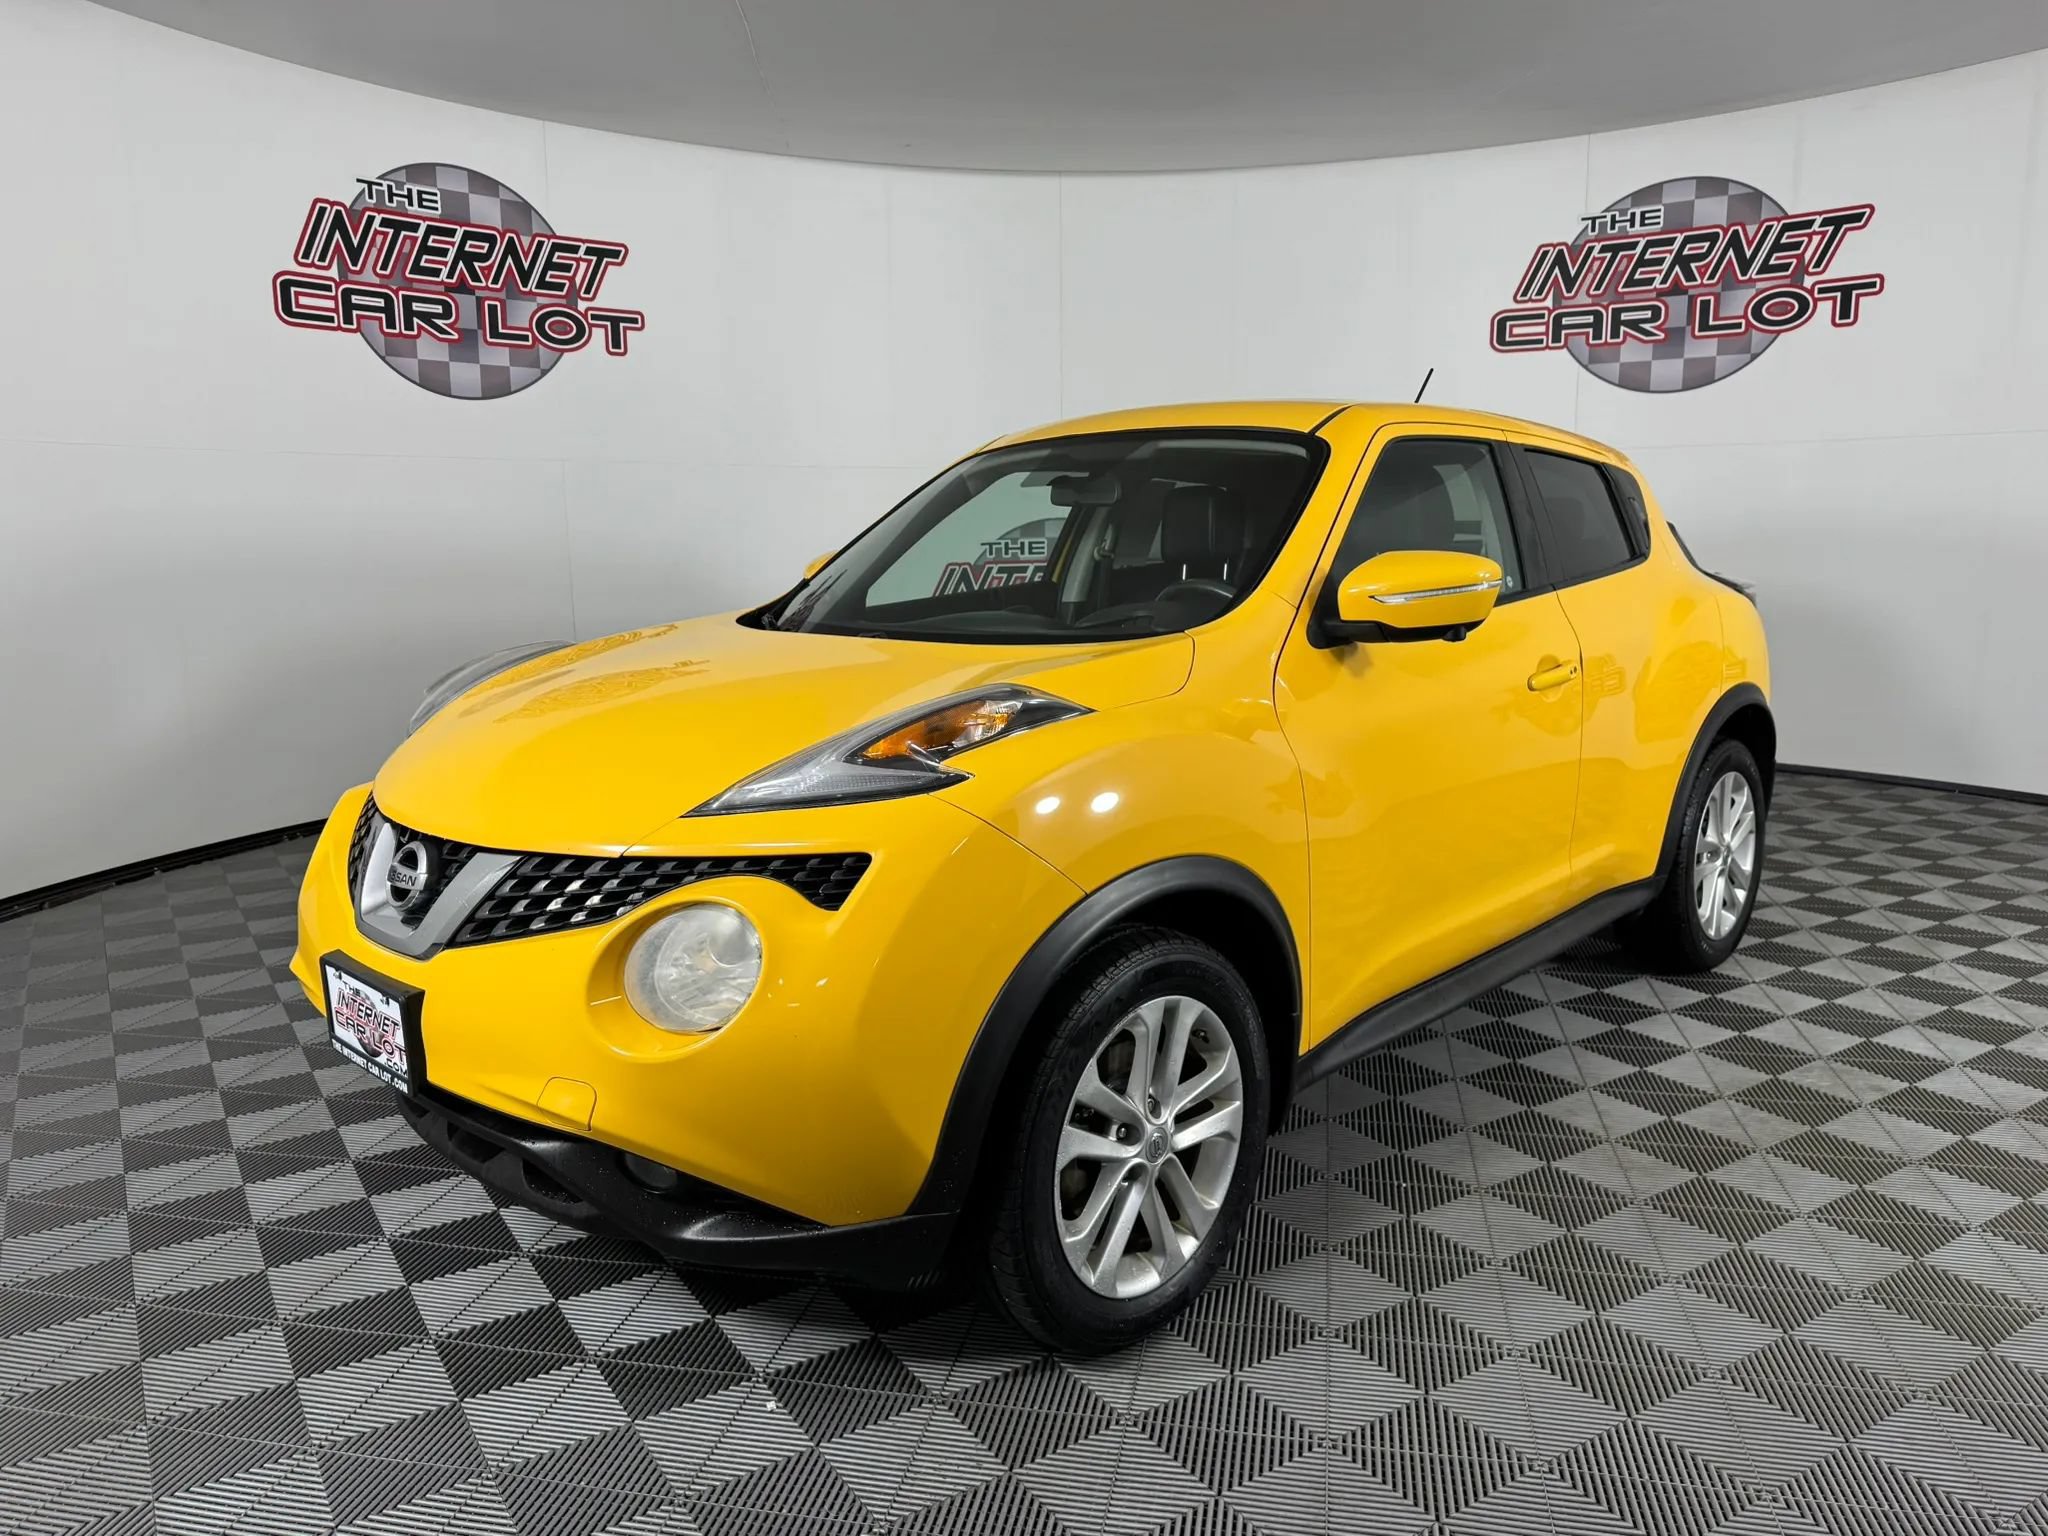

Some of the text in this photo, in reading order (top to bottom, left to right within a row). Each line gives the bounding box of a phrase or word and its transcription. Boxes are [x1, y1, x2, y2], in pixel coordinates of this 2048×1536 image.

[356, 177, 440, 212] THE
[1580, 206, 1663, 233] THE
[297, 201, 626, 298] INTERNET
[1516, 207, 1872, 300] INTERNET
[276, 274, 643, 353] CAR LOT
[1493, 277, 1882, 350] CAR LOT
[981, 539, 1047, 557] THE
[338, 989, 400, 1036] INTERNET
[342, 981, 361, 997] THE
[335, 1009, 407, 1063] CAR LOT
[367, 1062, 380, 1078] CAR
[380, 1069, 392, 1084] LOT
